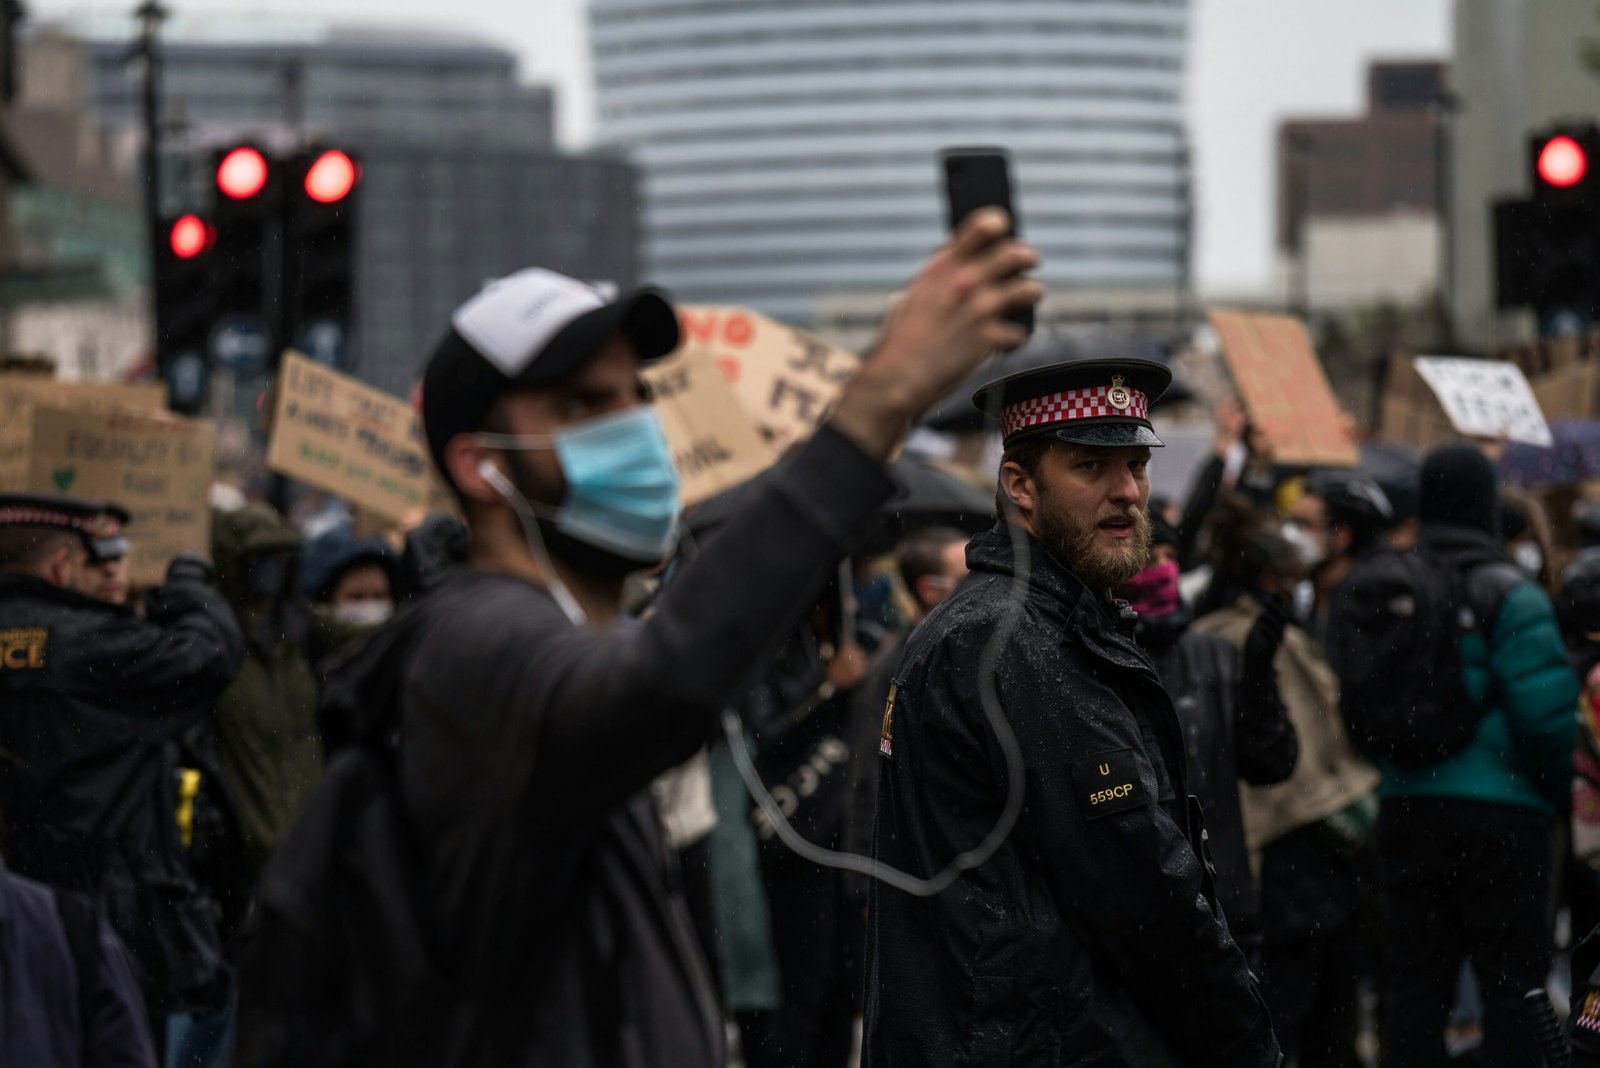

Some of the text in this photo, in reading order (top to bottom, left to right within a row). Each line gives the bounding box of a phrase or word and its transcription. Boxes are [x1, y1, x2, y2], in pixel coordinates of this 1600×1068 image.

[680, 309, 756, 348] NO
[1099, 763, 1110, 775] U
[1090, 783, 1133, 805] 559CP
